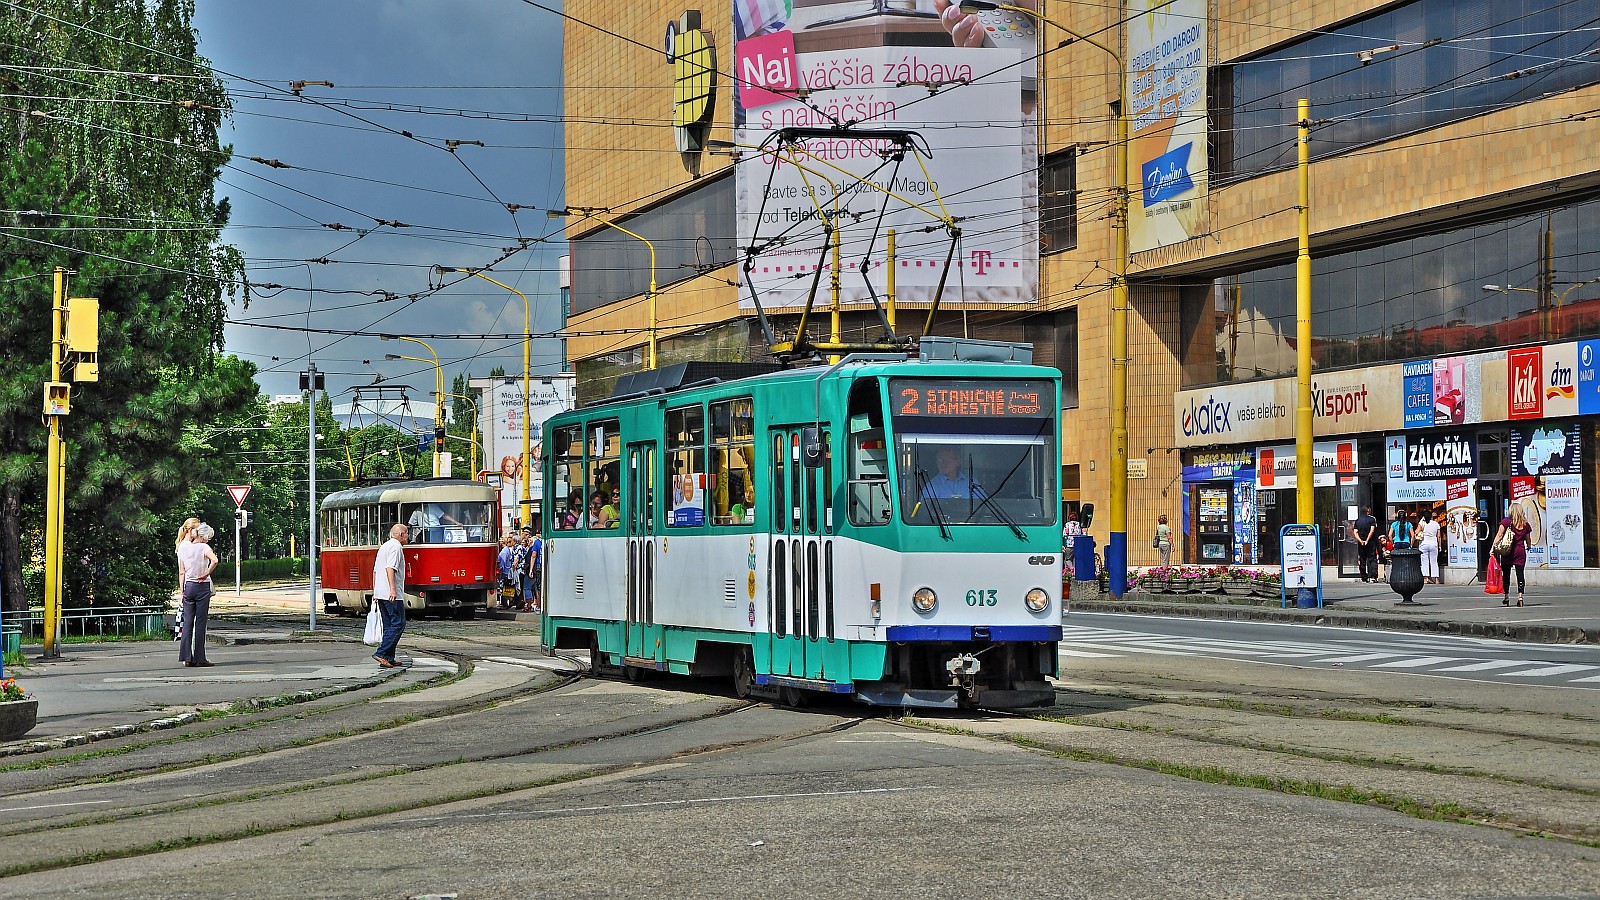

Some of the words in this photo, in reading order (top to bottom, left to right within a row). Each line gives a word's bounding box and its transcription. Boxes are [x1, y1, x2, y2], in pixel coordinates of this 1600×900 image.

[1161, 39, 1171, 58] OD
[742, 47, 792, 89] Naj
[801, 58, 875, 88] väčšia
[882, 55, 973, 84] zábava
[761, 110, 773, 130] s
[782, 95, 898, 129] najväčším
[763, 184, 797, 201] Bavte
[894, 176, 939, 195] Magio
[763, 208, 779, 224] od
[971, 251, 991, 275] T
[1514, 362, 1538, 404] kik
[1551, 361, 1571, 387] dm
[901, 388, 919, 415] 2
[927, 388, 1005, 402] STANIČNÉ
[1407, 393, 1430, 408] CAFFE
[927, 401, 1005, 415] NÁMESTIE
[1237, 404, 1256, 422] vaše
[1257, 402, 1286, 420] elektro
[1409, 435, 1472, 467] ZÁLOŽŇA
[1396, 485, 1436, 499] www.kasa.sk
[1547, 487, 1580, 499] DIAMANTY
[451, 569, 466, 577] 413
[965, 589, 998, 607] 613
